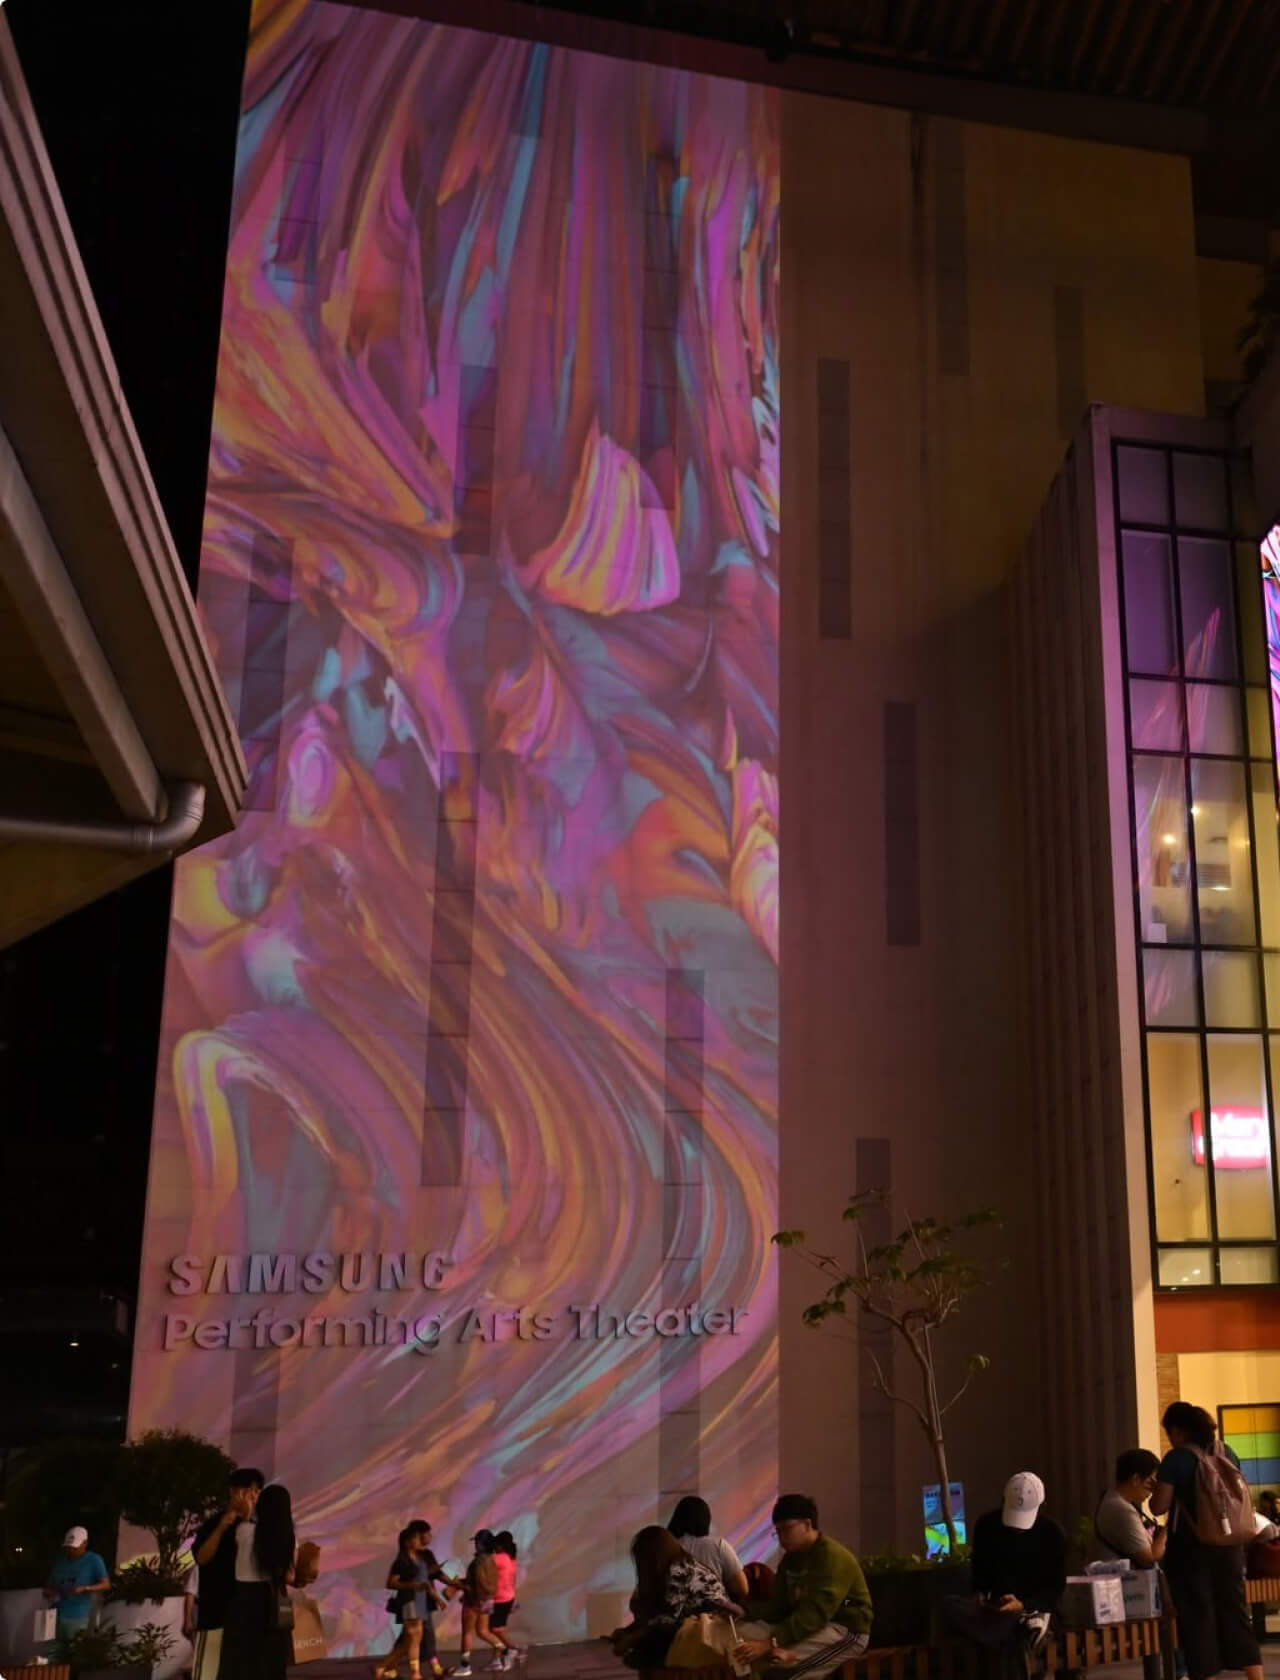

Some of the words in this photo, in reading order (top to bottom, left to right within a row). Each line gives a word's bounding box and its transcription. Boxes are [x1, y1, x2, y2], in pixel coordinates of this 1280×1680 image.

[168, 1252, 453, 1294] SAMSUNG
[164, 1307, 442, 1356] Performing
[456, 1304, 555, 1342] Arts
[568, 1302, 749, 1338] Theater
